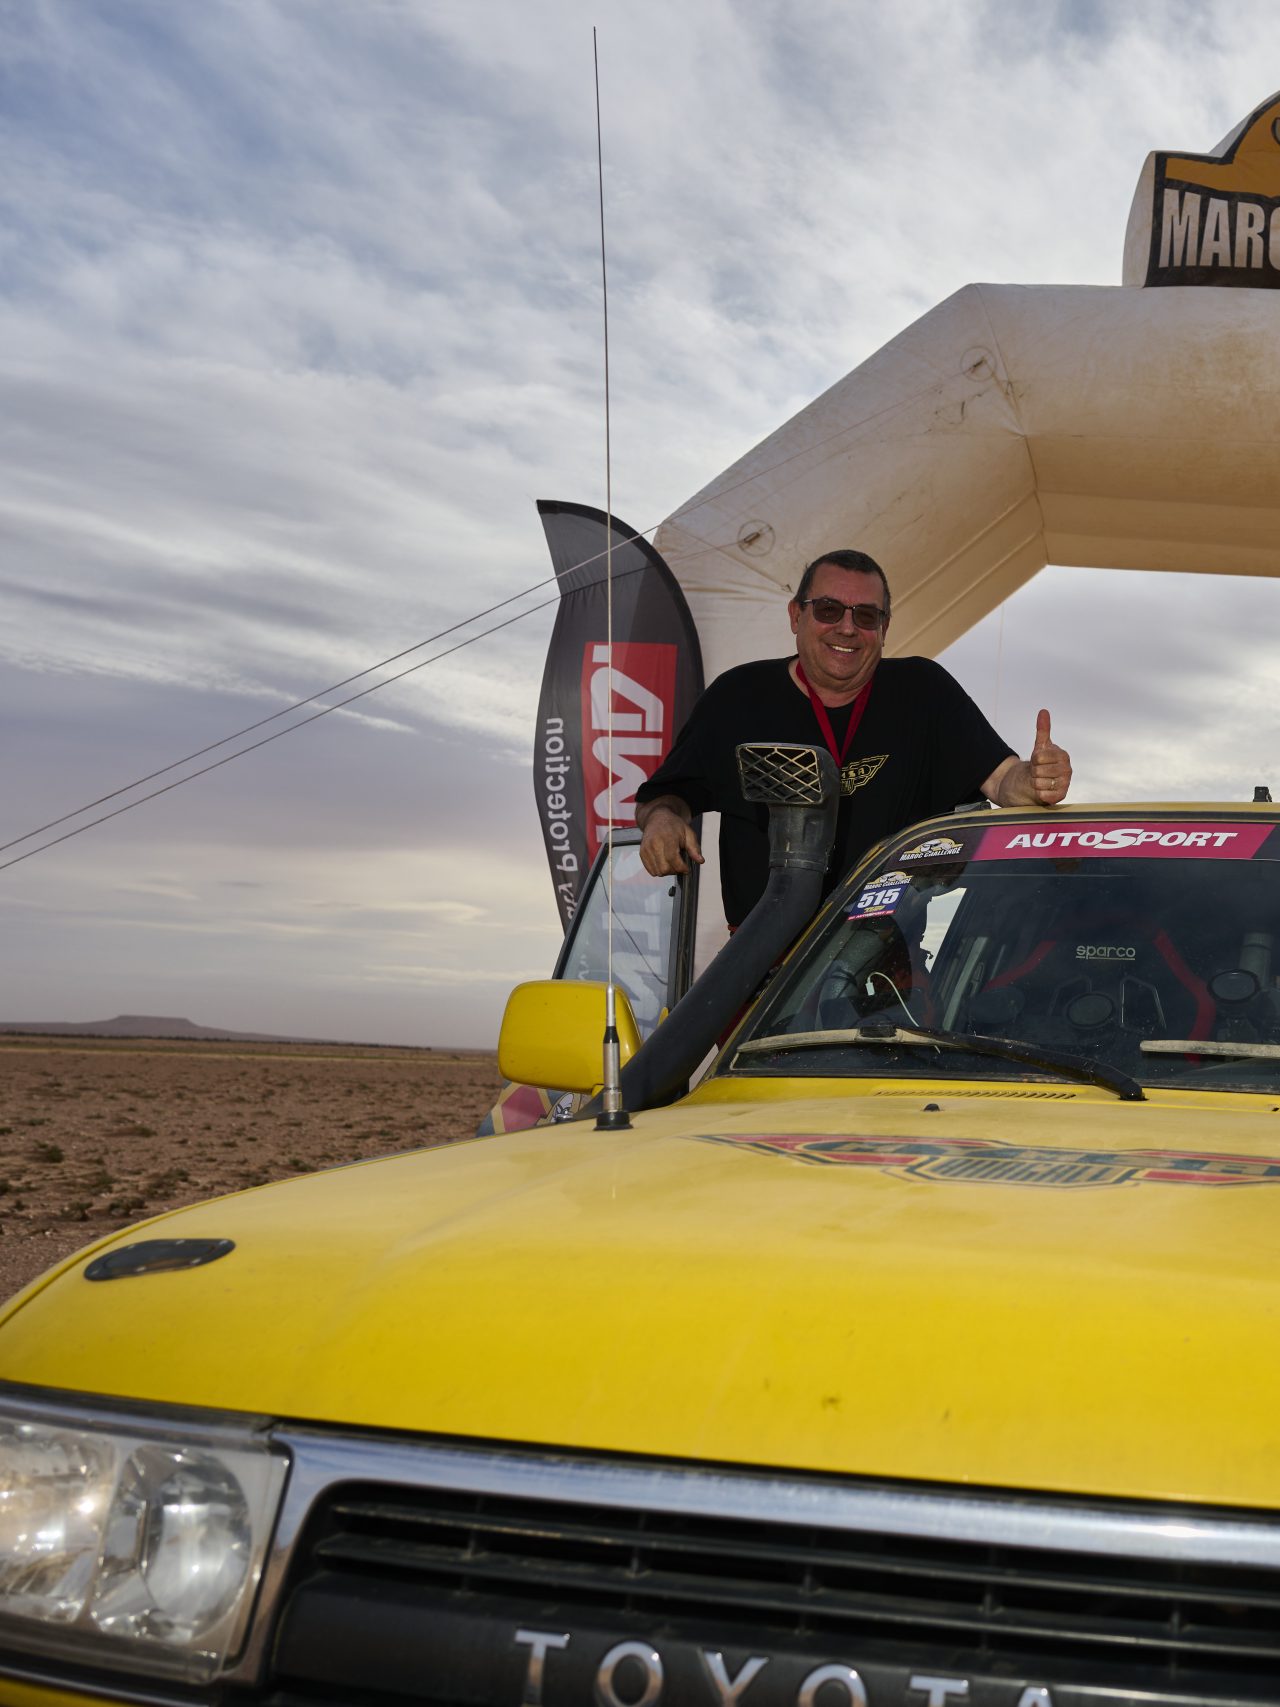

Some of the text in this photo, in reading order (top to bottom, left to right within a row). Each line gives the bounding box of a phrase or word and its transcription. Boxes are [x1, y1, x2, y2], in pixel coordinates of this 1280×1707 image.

[1005, 828, 1239, 850] AUTOSPORT
[899, 847, 962, 861] MAROC CHALLENGE
[857, 887, 902, 908] 515
[1075, 945, 1136, 960] sparco
